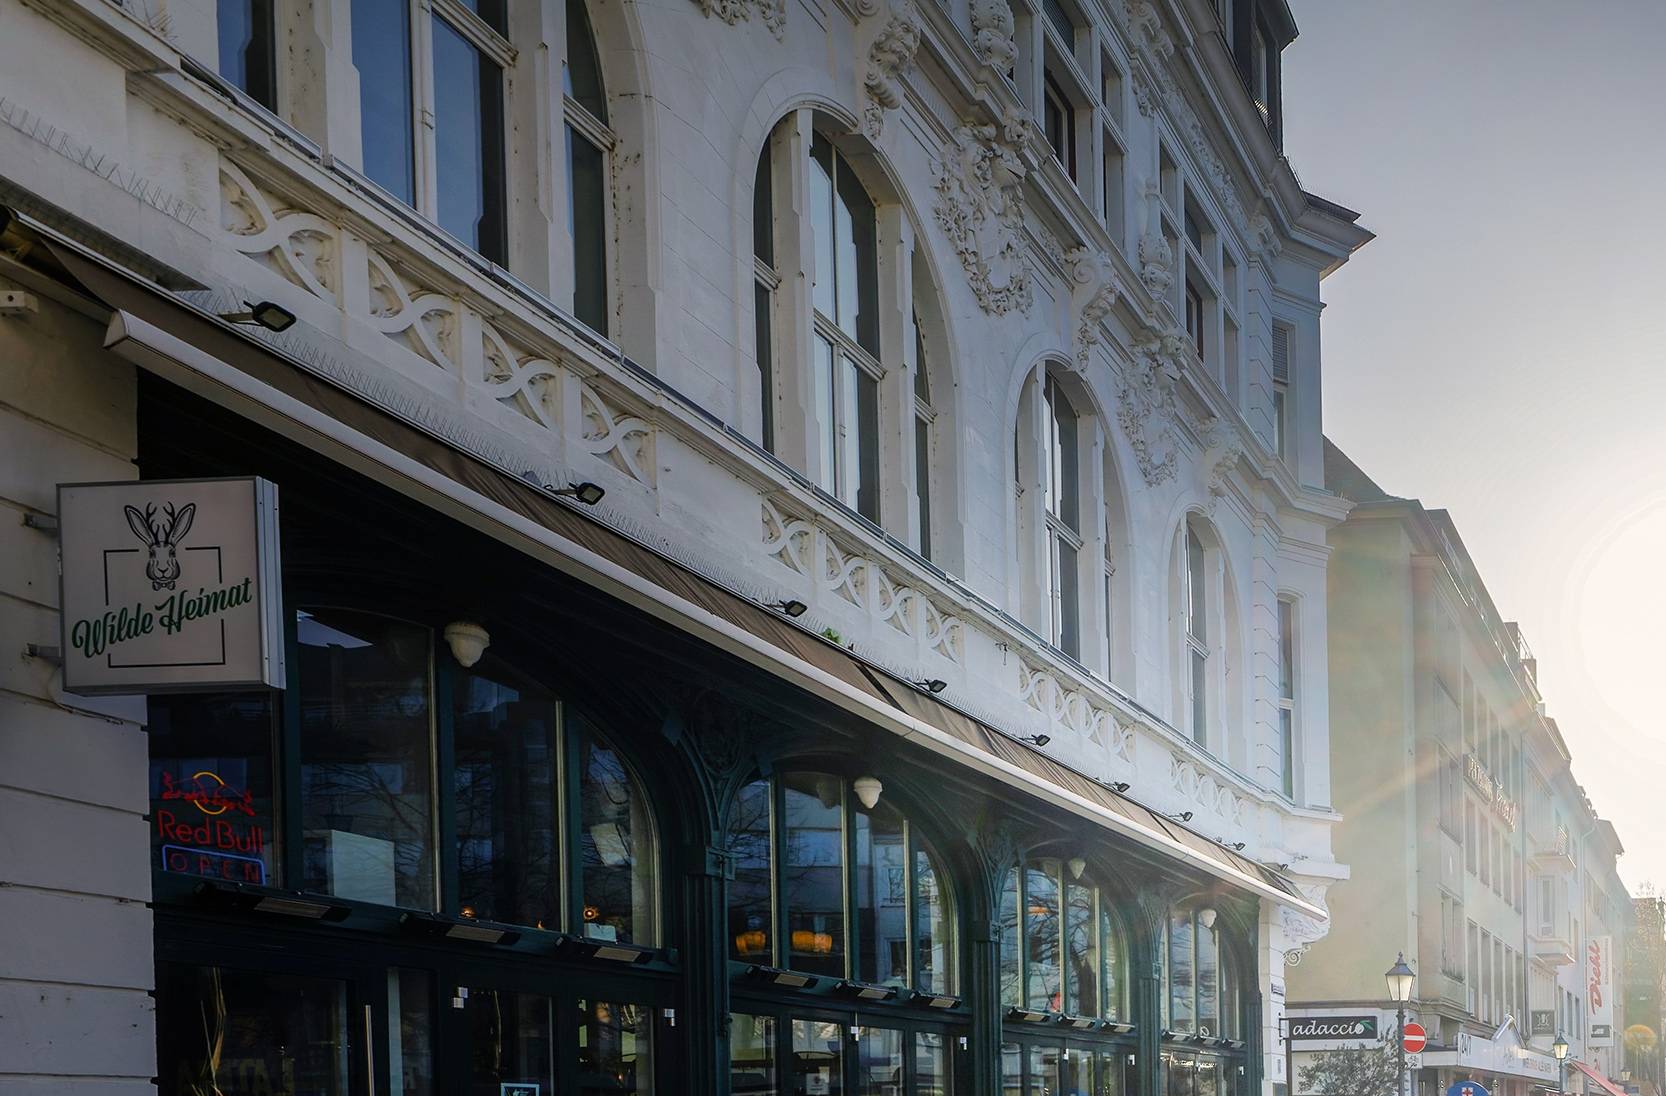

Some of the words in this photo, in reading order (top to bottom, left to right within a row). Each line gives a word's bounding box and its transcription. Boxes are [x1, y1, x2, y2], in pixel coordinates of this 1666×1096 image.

[72, 603, 154, 658] Wilde
[155, 577, 252, 635] Heimat
[158, 810, 211, 844] Red
[216, 821, 264, 853] Bull
[170, 853, 260, 883] OPEN
[1588, 939, 1603, 1015] Diehl
[1292, 1020, 1365, 1036] adaccio
